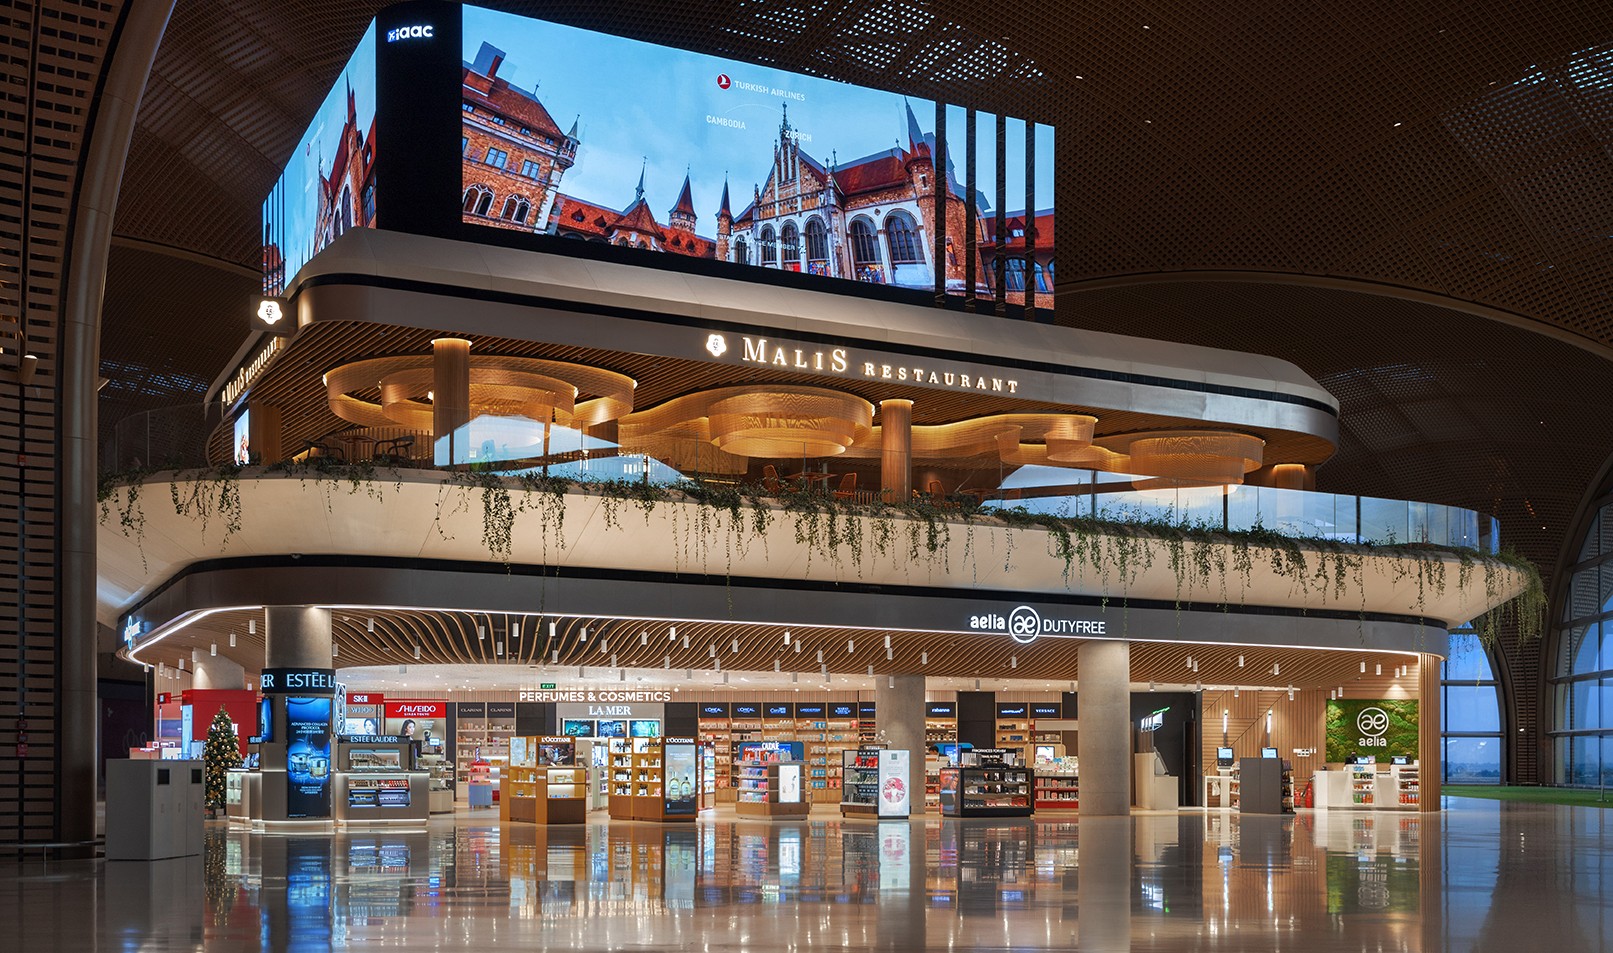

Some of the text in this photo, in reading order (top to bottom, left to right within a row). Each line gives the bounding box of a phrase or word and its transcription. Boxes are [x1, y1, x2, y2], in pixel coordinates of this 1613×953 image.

[734, 80, 805, 102] TURKISH AIRLINES
[706, 115, 746, 130] CAMBODIA
[785, 130, 812, 142] ZURICH
[742, 336, 1018, 394] MALIS RESTAURANT
[970, 614, 1005, 630] aelia
[1043, 619, 1106, 634] DUTYFREE
[519, 692, 671, 702] PERFUMES & COSMETICS
[396, 704, 436, 713] SHISEIDO
[589, 705, 632, 716] LA MER
[1358, 736, 1387, 747] aelia
